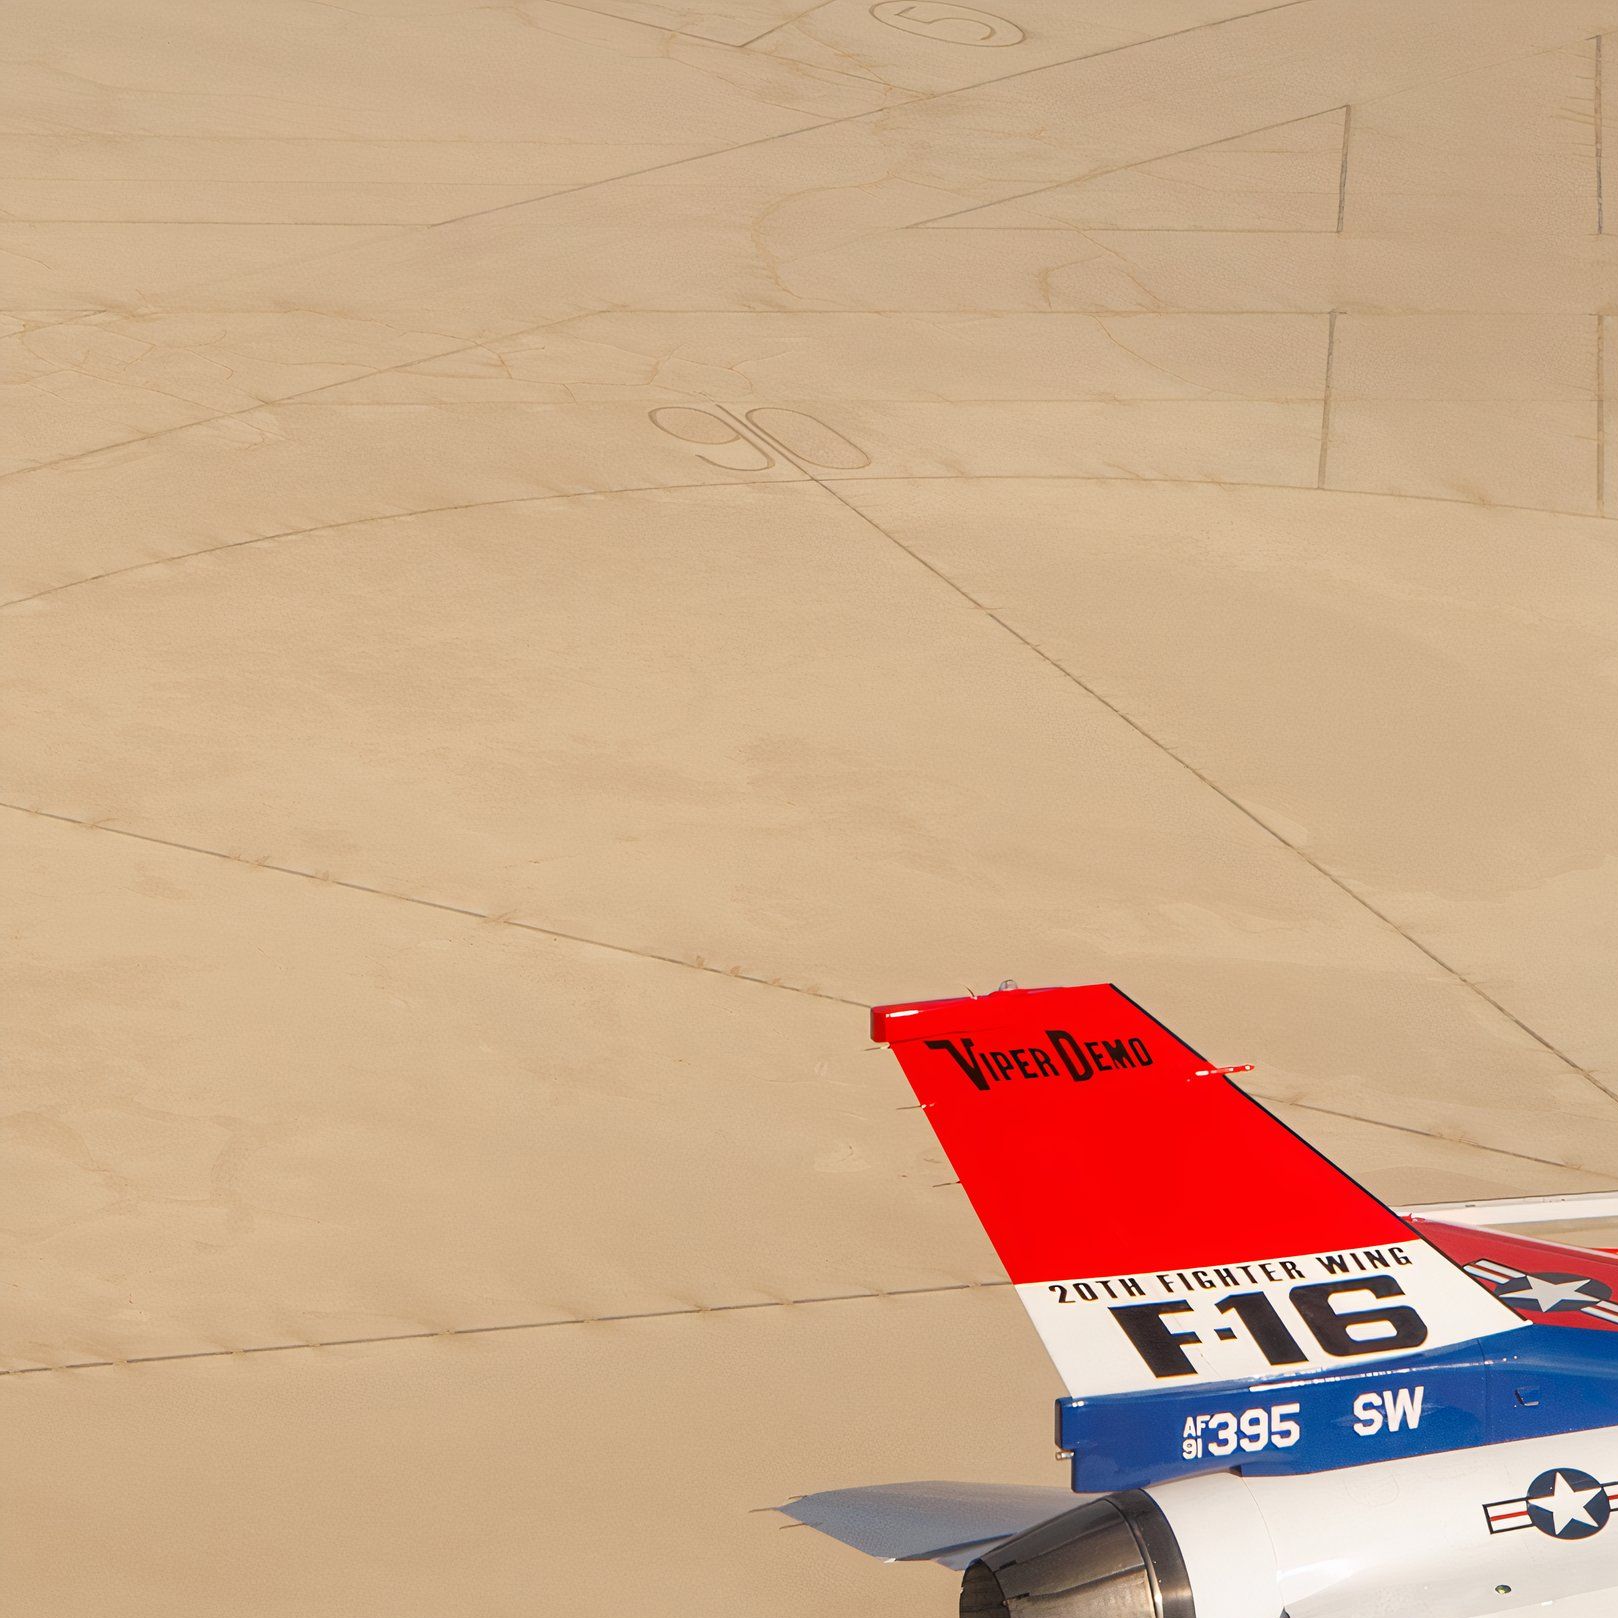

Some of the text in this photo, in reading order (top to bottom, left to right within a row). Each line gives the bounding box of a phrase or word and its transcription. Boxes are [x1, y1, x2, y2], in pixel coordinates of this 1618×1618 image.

[647, 406, 872, 472] 90
[1048, 1246, 1414, 1304] 20TH FIGHTER WING
[1107, 1274, 1429, 1379] F-16
[1182, 1415, 1210, 1438] AF
[1207, 1402, 1301, 1457] 395
[1353, 1385, 1425, 1437] SW
[1182, 1438, 1203, 1460] 91
